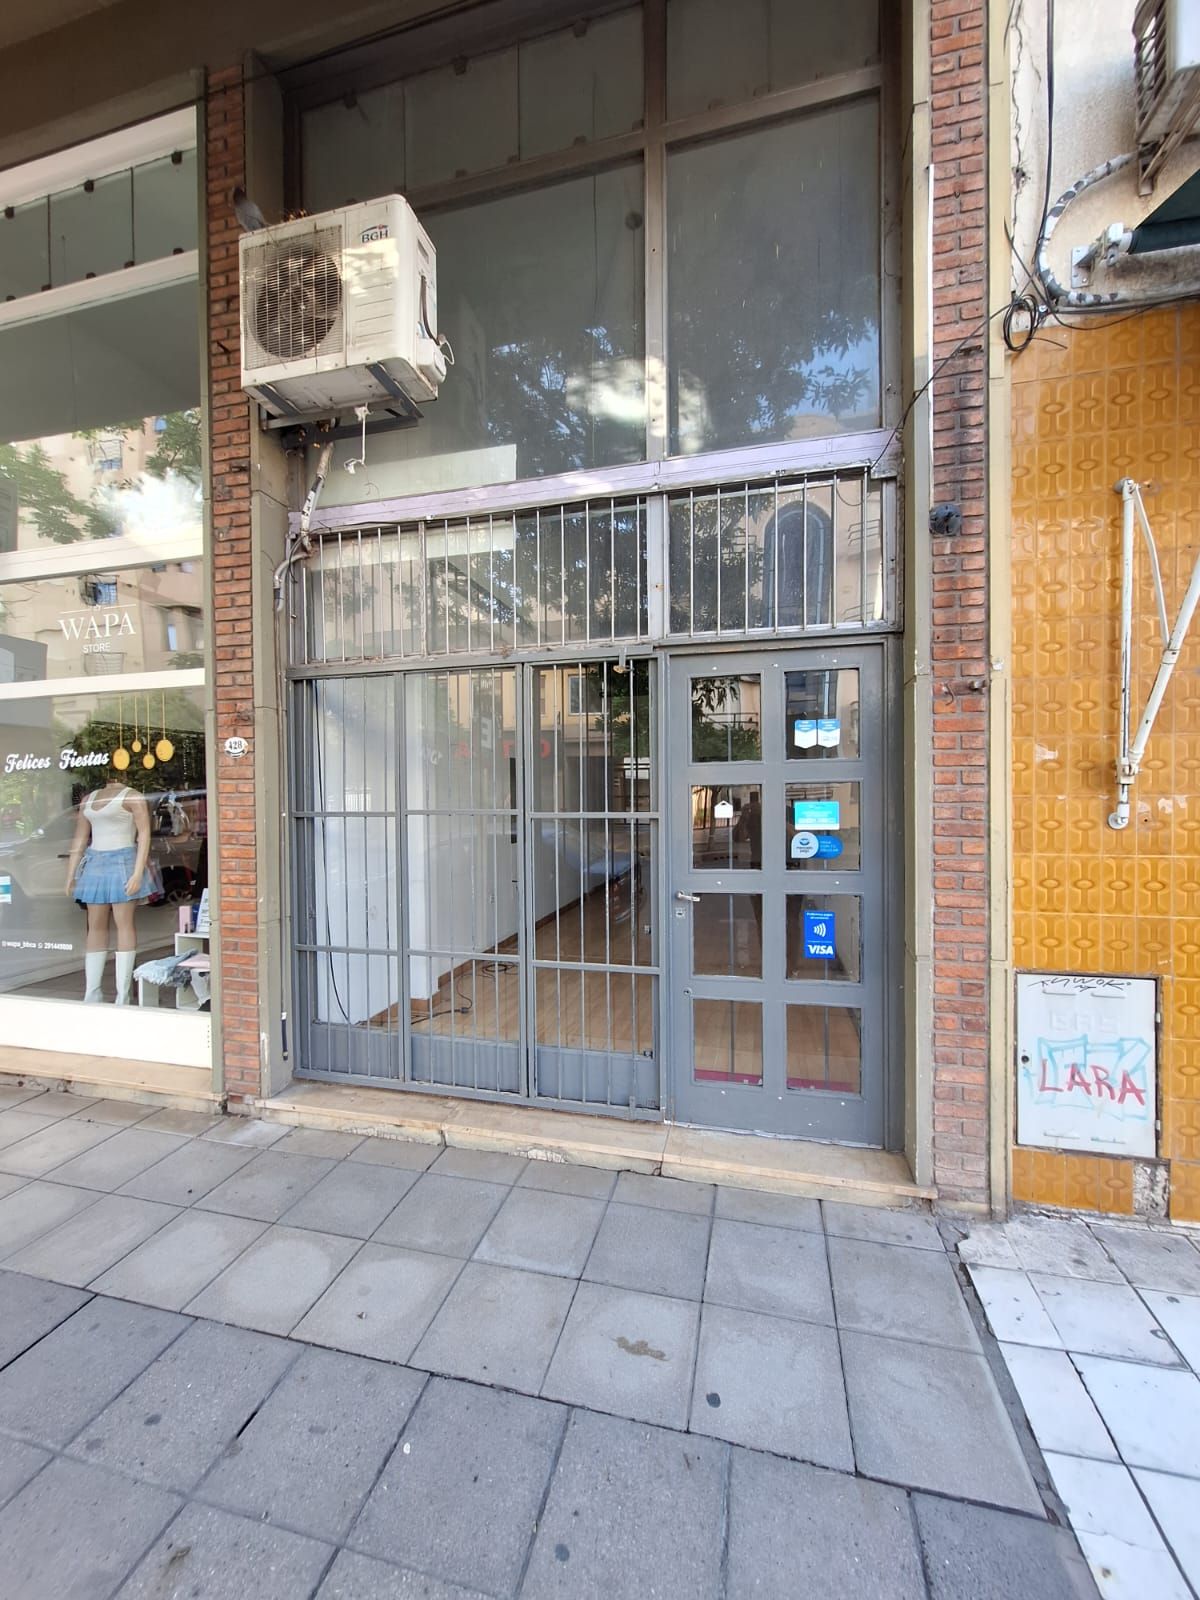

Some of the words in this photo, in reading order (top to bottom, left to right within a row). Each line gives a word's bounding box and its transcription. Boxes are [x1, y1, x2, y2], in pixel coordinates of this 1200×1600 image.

[361, 229, 389, 243] BGH
[57, 611, 137, 641] WAPA
[82, 642, 111, 654] STORE
[4, 753, 51, 774] Felices
[59, 748, 110, 770] Fiestas
[807, 944, 834, 955] VISA
[1038, 1058, 1147, 1106] LARA
